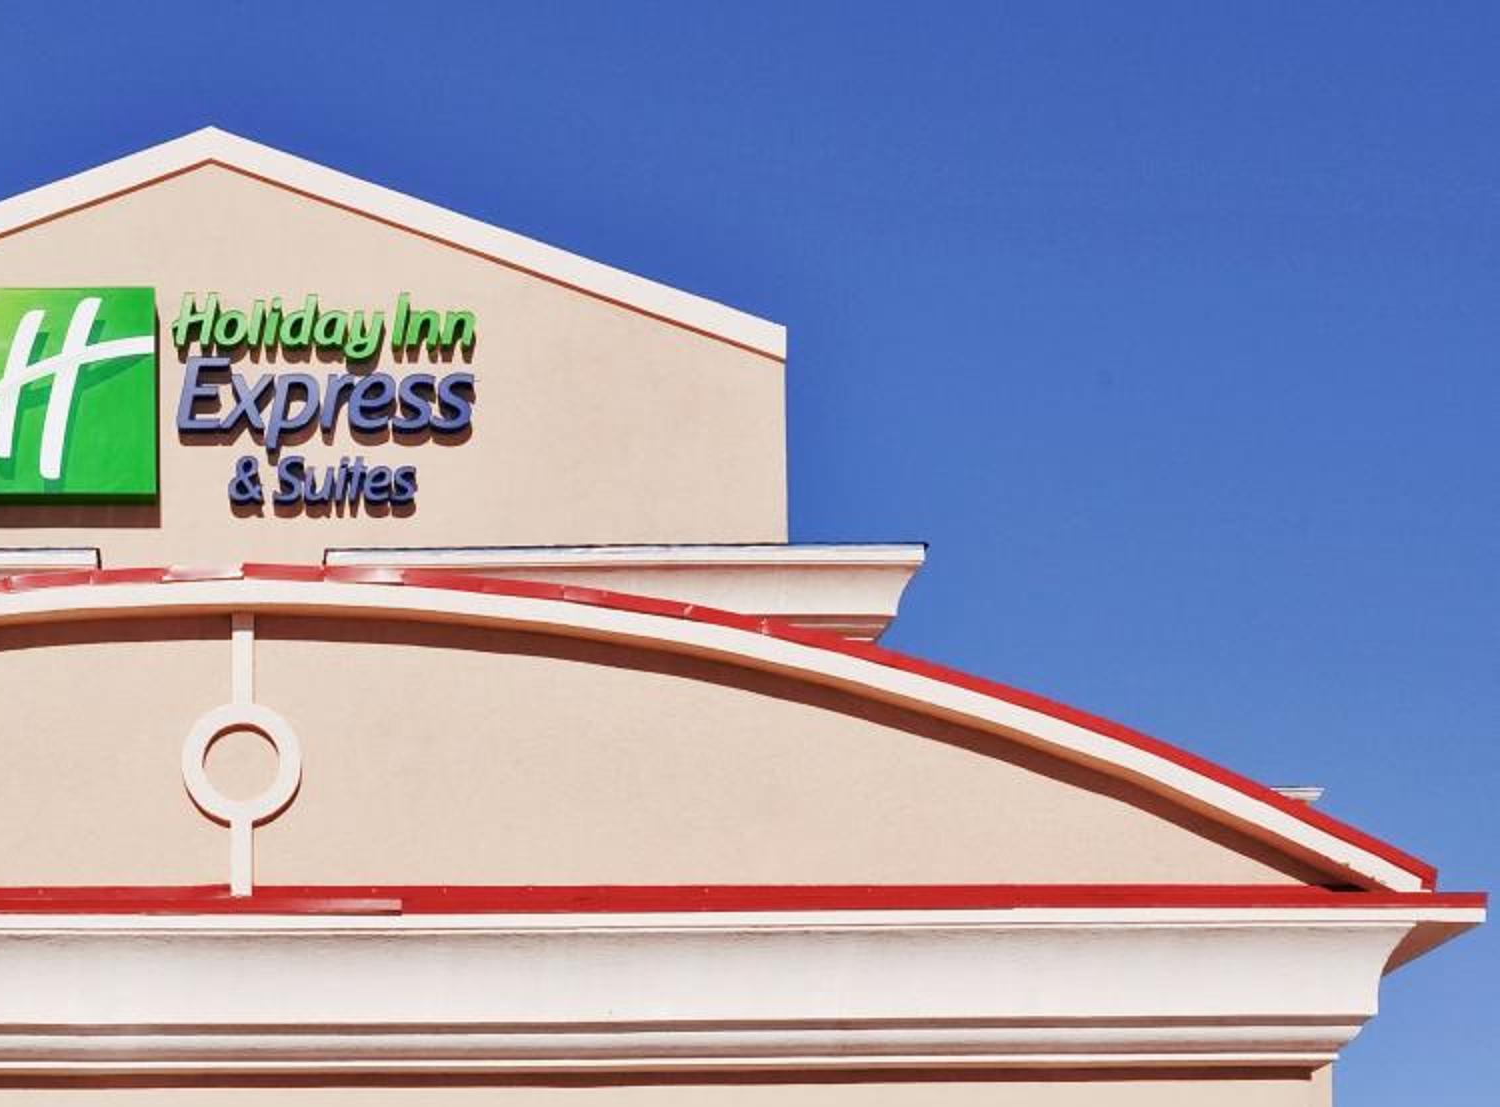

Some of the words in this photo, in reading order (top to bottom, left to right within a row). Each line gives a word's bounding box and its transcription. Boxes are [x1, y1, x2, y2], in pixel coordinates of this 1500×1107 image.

[171, 291, 385, 359] Holiday
[391, 291, 476, 346] Inn
[176, 356, 475, 450] Express
[228, 455, 263, 502] &
[273, 455, 418, 502] Suites
